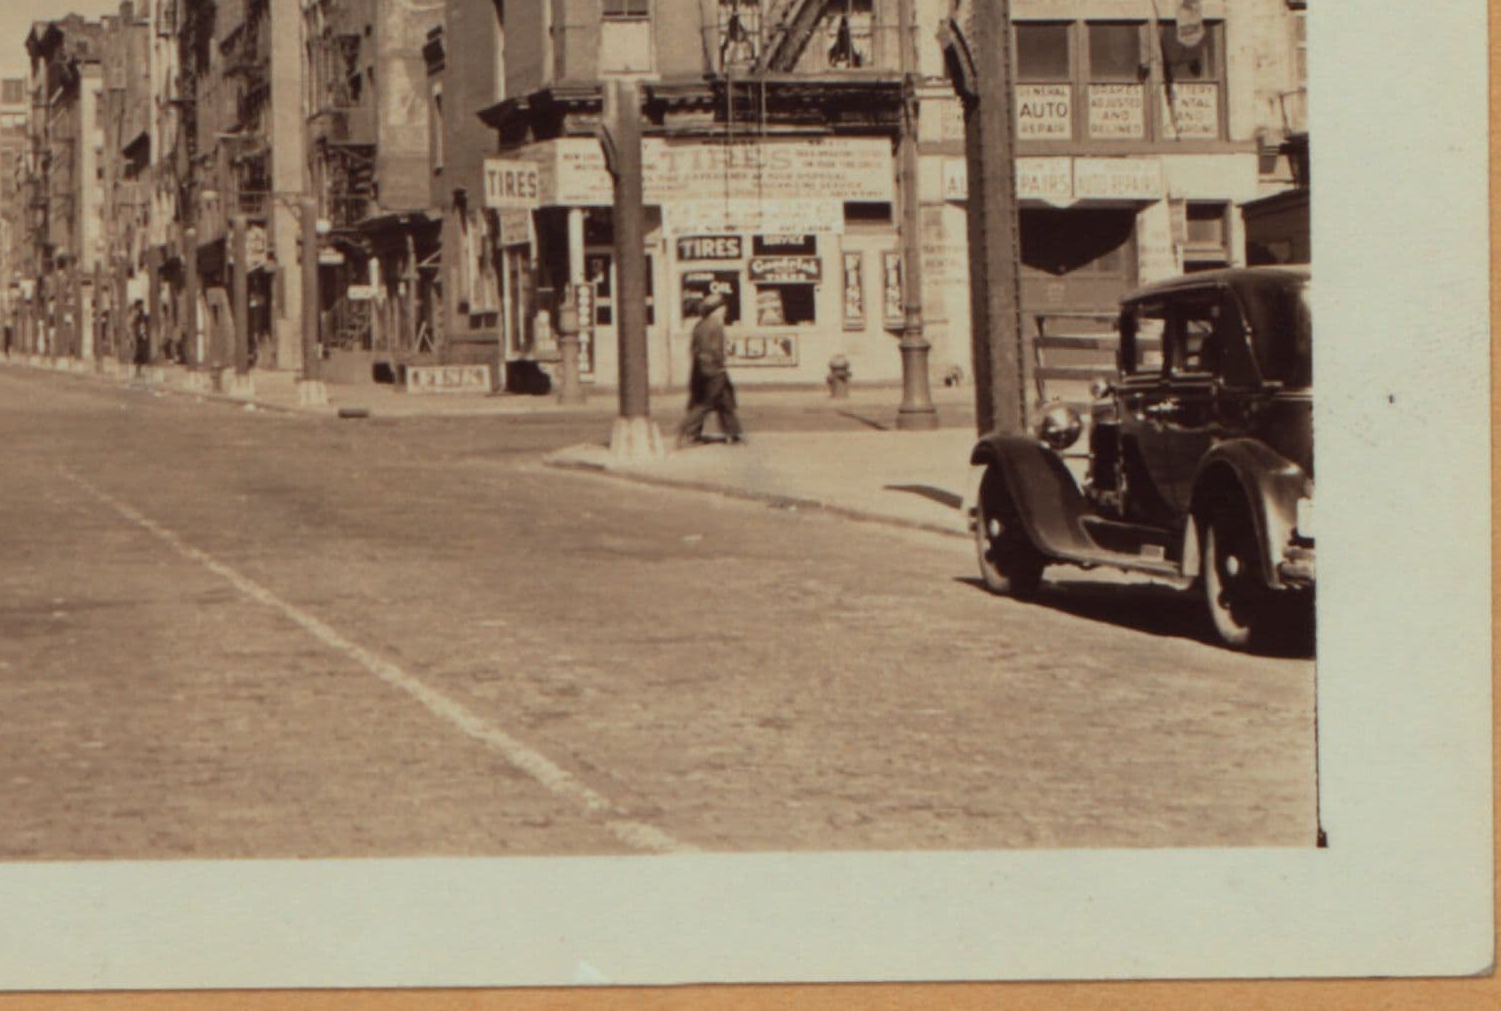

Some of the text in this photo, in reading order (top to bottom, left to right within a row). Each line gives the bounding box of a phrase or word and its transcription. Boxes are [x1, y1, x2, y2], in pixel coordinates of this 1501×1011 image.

[1019, 102, 1068, 119] AUTO
[1102, 111, 1130, 121] AND
[1020, 124, 1066, 134] REPAIR
[660, 148, 792, 171] TIRES
[487, 170, 537, 198] TIRES
[682, 237, 740, 259] TIRES
[844, 254, 861, 319] FISK
